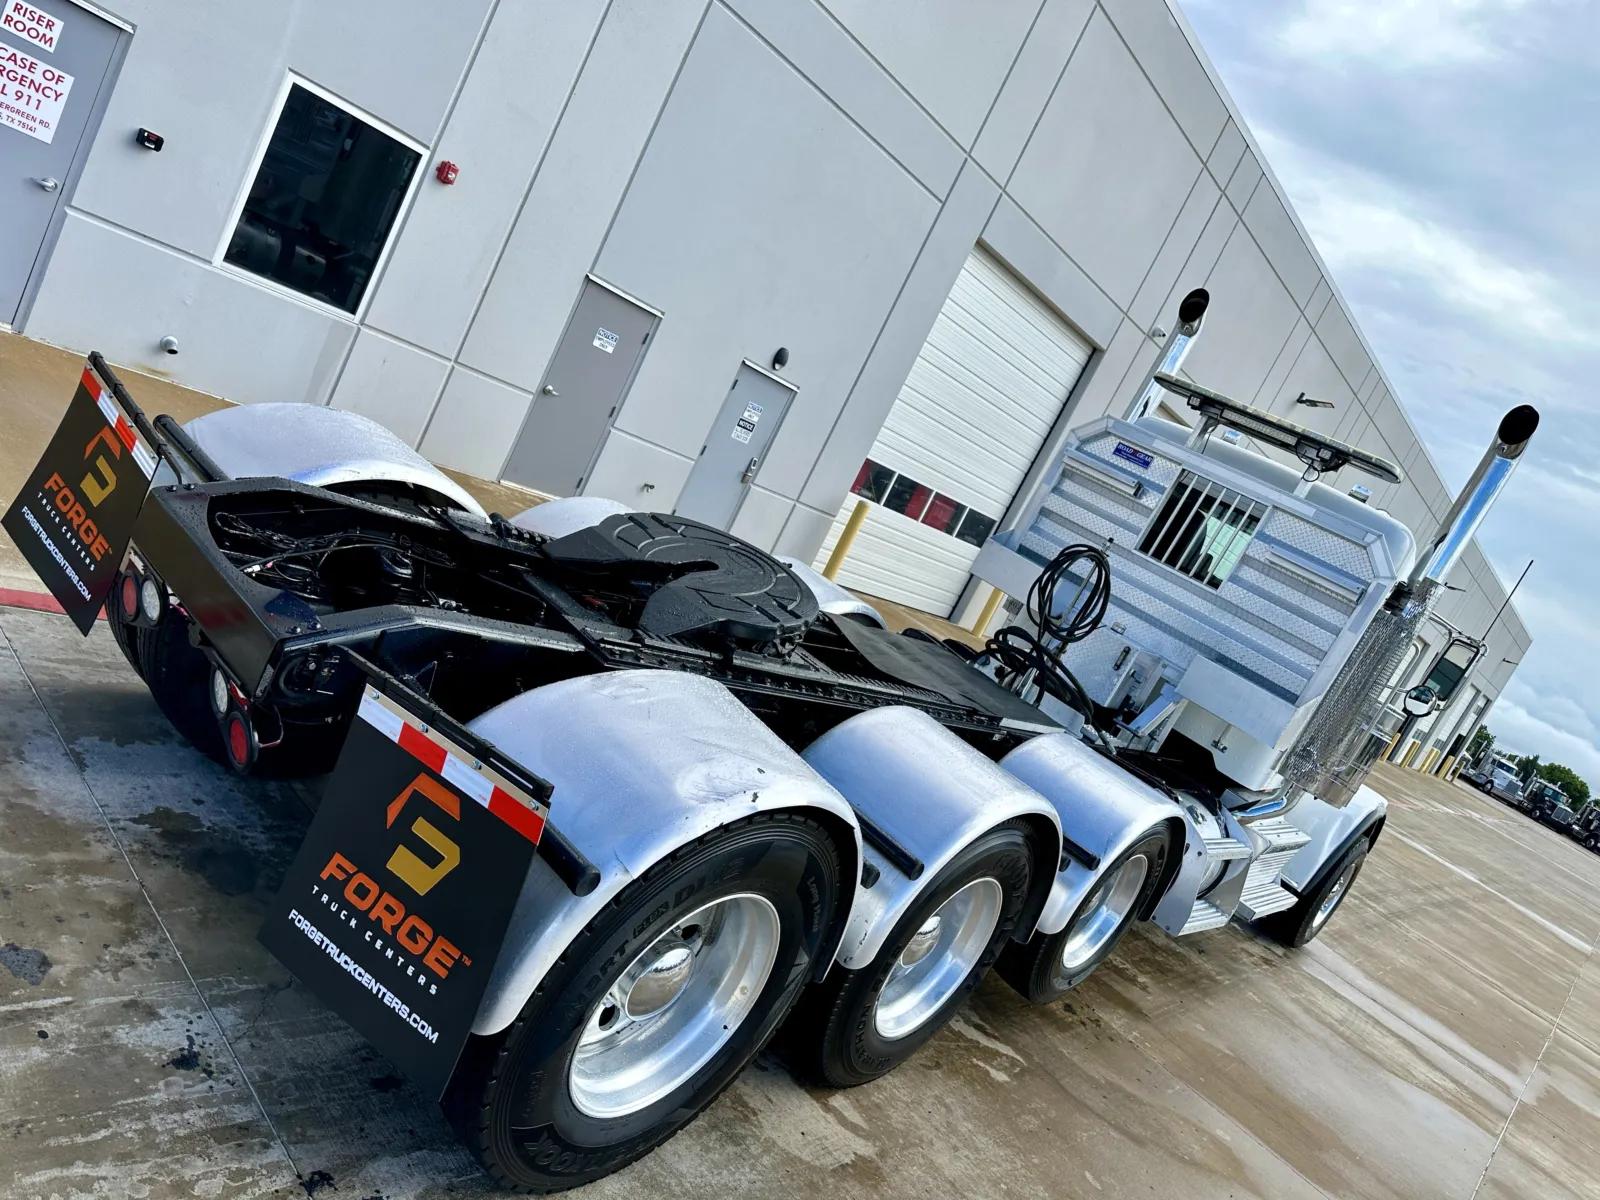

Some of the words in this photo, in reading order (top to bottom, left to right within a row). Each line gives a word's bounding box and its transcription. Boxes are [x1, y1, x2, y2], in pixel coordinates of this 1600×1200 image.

[3, 14, 53, 48] ROOM
[12, 2, 55, 32] RISER
[15, 90, 41, 110] 911
[42, 69, 65, 85] OF
[6, 115, 15, 124] TX
[21, 506, 92, 601] FORGETRUCKCENTERS.COM
[38, 492, 60, 523] TRUCK
[61, 526, 95, 571] CENTERS
[44, 472, 109, 561] FORGE
[311, 884, 357, 929] TRUCK
[364, 930, 438, 995] CENTERS
[319, 851, 461, 979] FORGE
[287, 908, 439, 1044] FORGETRUCKCENTERS.COM
